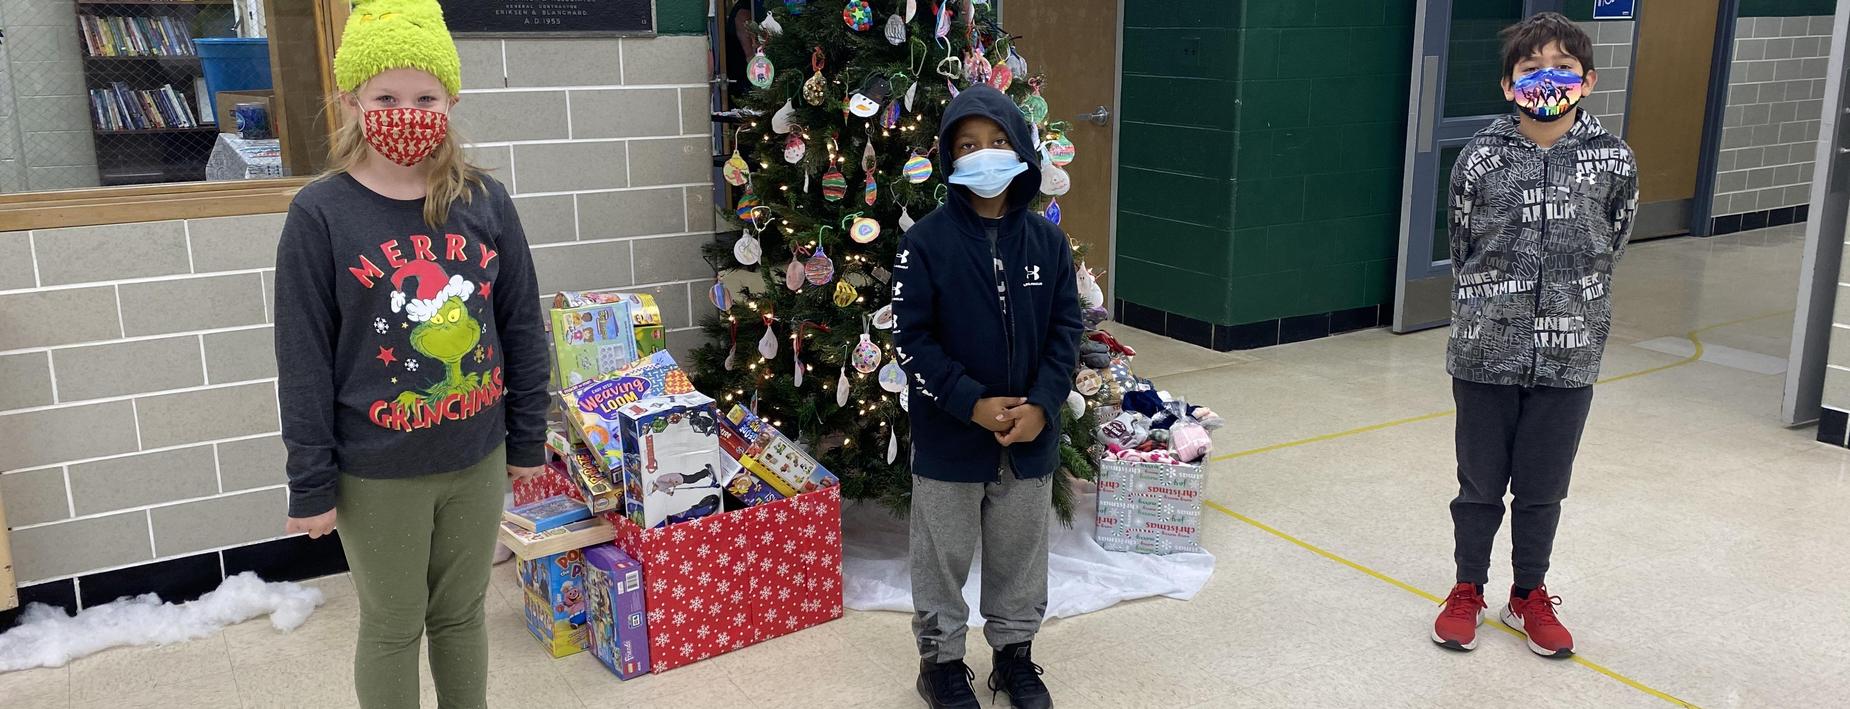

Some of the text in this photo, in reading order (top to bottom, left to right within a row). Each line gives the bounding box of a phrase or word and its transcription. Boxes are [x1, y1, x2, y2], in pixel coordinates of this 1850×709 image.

[1577, 148, 1629, 160] UNDER
[1576, 160, 1631, 176] ARMOUR
[349, 234, 497, 288] MERRY
[1534, 316, 1585, 331] UNDER
[1534, 331, 1590, 348] ARMOUR
[579, 379, 646, 412] Weaving
[600, 391, 639, 413] LOOM
[1148, 486, 1197, 498] christmas
[1146, 522, 1195, 534] christmas
